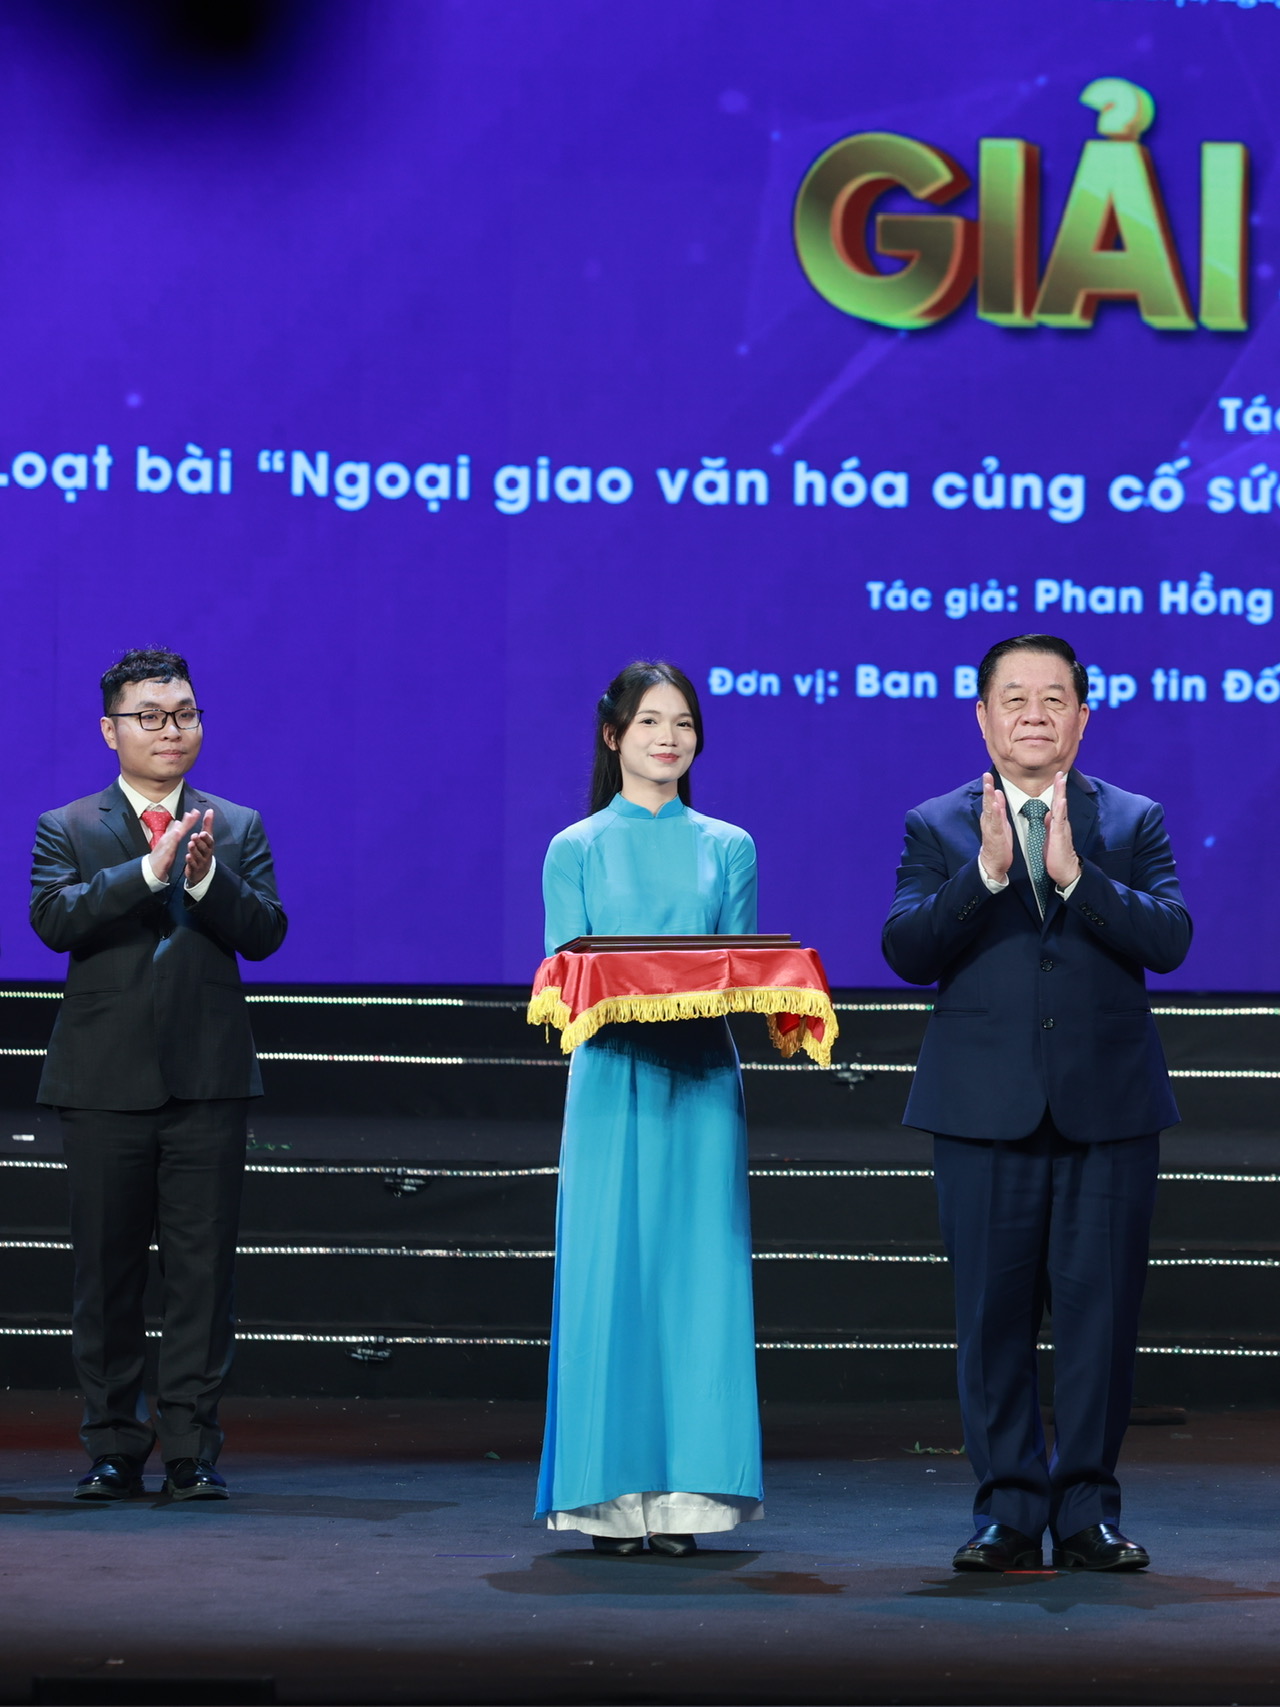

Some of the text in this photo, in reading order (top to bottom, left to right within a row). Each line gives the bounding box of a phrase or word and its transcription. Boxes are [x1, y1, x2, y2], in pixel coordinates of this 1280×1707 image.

[795, 77, 1250, 331] GIẢI
[0, 444, 113, 503] oạt
[136, 443, 232, 495] bài
[257, 449, 470, 513] “Ngoại
[493, 456, 634, 515] giao
[656, 456, 769, 506] văn
[793, 457, 909, 509] hóa
[932, 456, 1086, 524] củng
[1108, 456, 1191, 513] cố
[866, 579, 932, 612] Tác
[944, 579, 1018, 619] giả:
[1035, 578, 1143, 615] Phan
[1159, 571, 1274, 625] Hồng
[708, 666, 780, 697] Đơn
[793, 669, 839, 704] vị:
[855, 664, 938, 699] Ban
[1087, 664, 1137, 710] ập
[1151, 668, 1207, 702] tin
